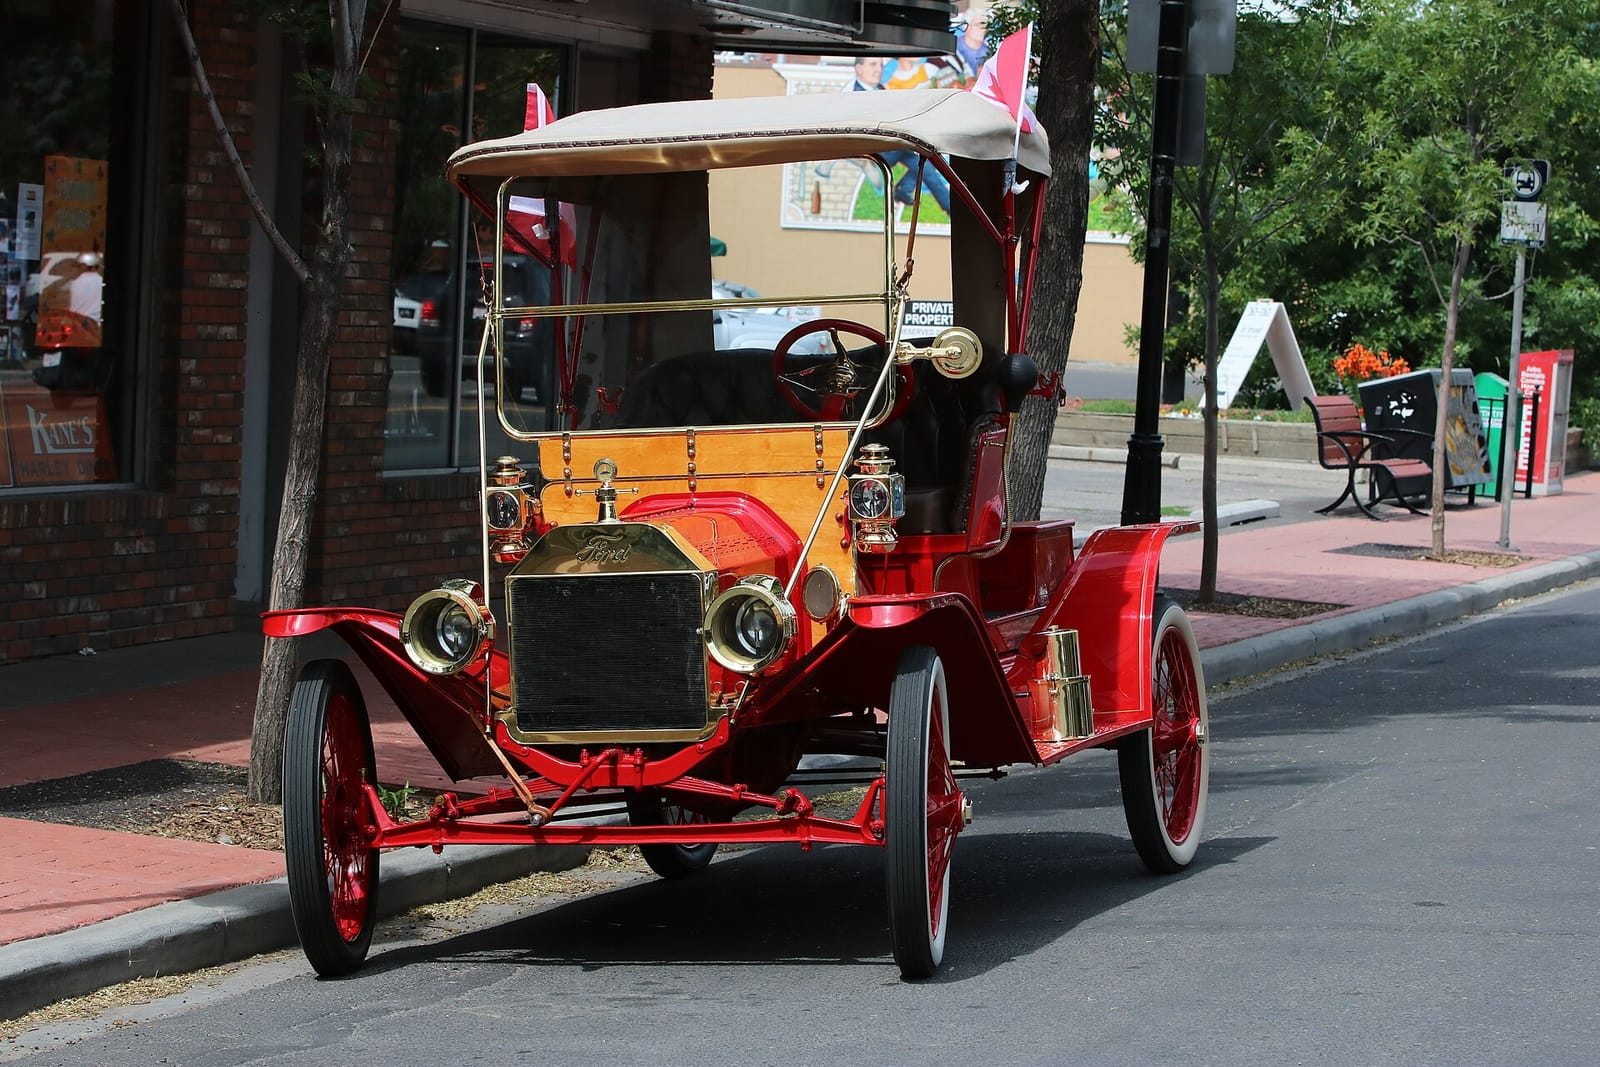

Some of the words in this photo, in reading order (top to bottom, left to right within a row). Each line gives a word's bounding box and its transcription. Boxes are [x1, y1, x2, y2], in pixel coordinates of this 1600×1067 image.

[912, 302, 953, 313] PRIVATE
[904, 314, 953, 325] PROPERT
[902, 327, 934, 336] ESERVED
[1520, 383, 1544, 391] Homs
[25, 404, 95, 454] KANE'S
[576, 534, 632, 565] Ford
